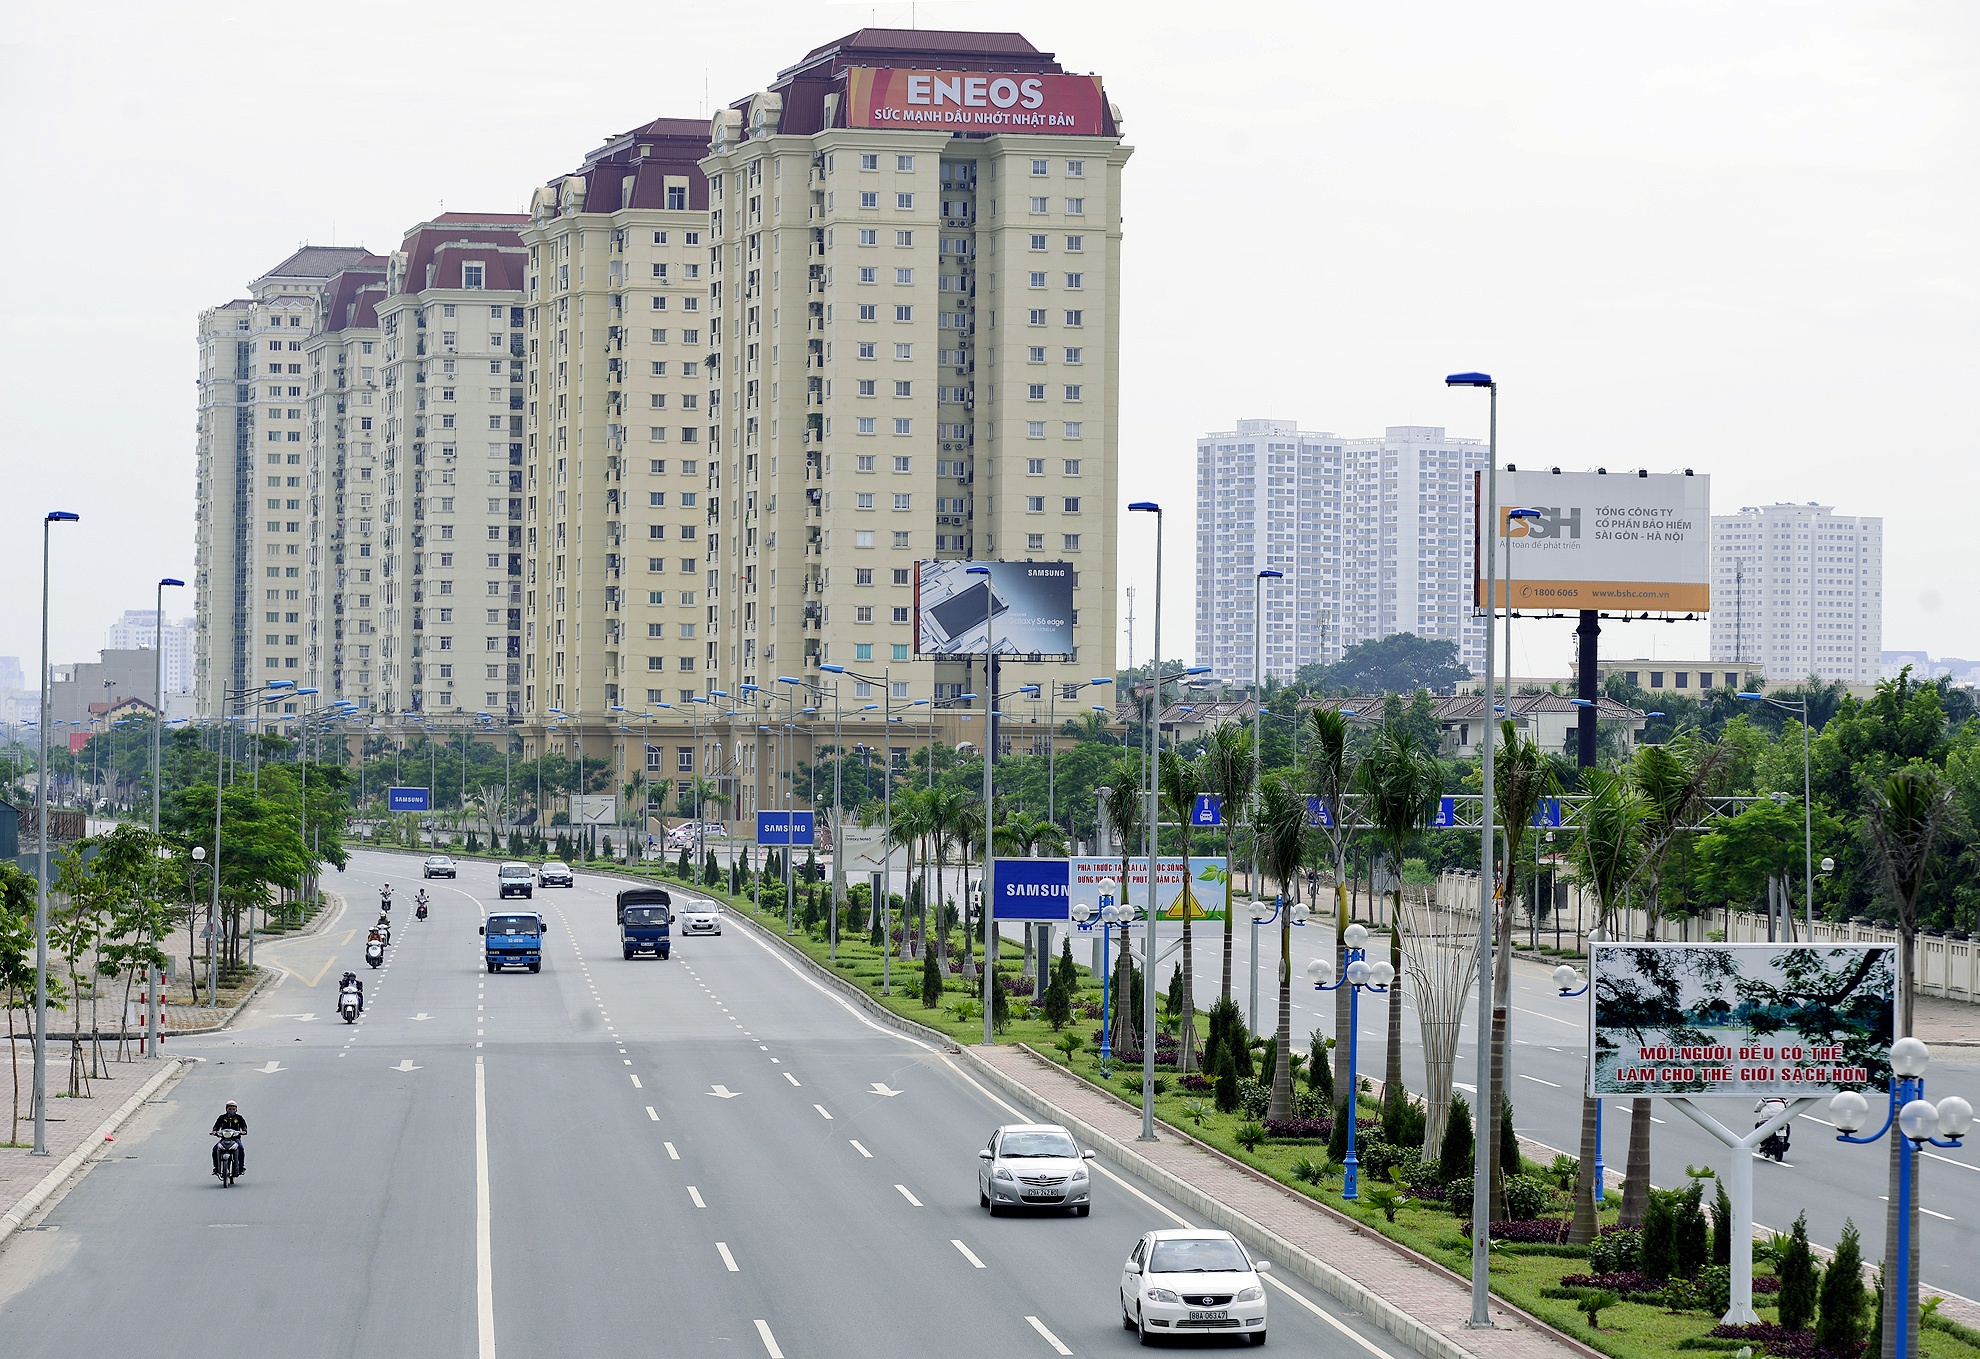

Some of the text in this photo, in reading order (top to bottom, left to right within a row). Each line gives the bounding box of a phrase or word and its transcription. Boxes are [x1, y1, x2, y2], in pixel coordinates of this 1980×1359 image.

[907, 75, 1044, 109] ENEOS
[874, 107, 1075, 128] SỨC MẠNH DẦU NHỚT NHẬT BẢN
[1595, 505, 1673, 517] TỔNG CÔNG TY
[1500, 506, 1581, 539] BSH
[1642, 518, 1664, 529] BẢO
[1595, 529, 1612, 540] SÀI
[1614, 530, 1639, 540] GÒN
[1646, 530, 1662, 540] HÀ
[1664, 531, 1684, 543] NỘI
[1512, 541, 1530, 549] toàn
[1543, 541, 1561, 550] phát
[1027, 569, 1065, 577] SAMSUNG
[1534, 588, 1670, 599] 1800 6065 www.bshc.com.vn
[1008, 617, 1065, 627] Galaxy S6 edge
[1006, 883, 1070, 897] SAMSUN
[1640, 1042, 1844, 1061] MỖI NGƯỜI ĐỀU CÓ THỂ
[1617, 1064, 1867, 1084] LÀM CHO THẾ GIỚI SẠCH HƠN
